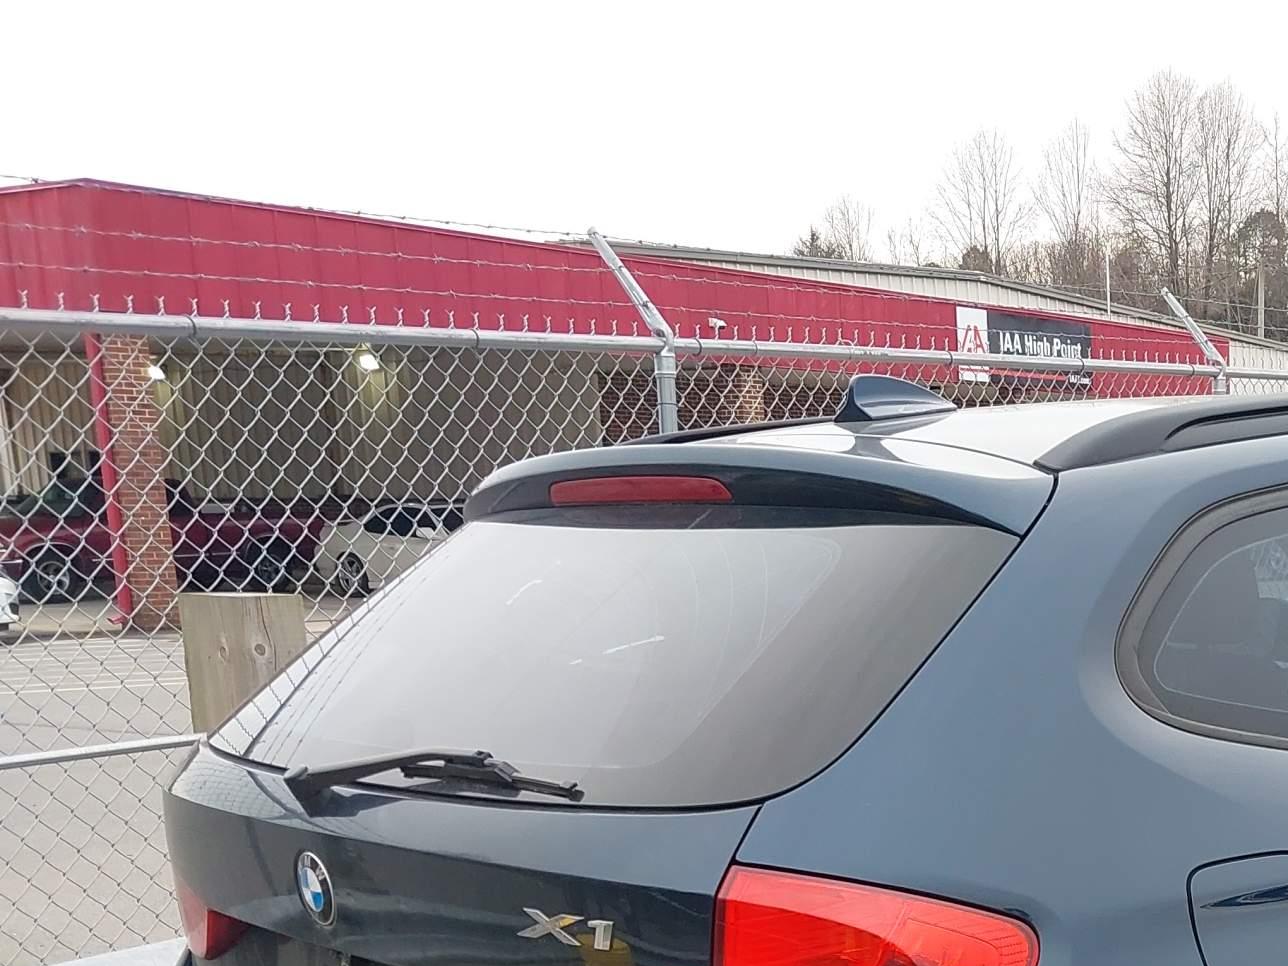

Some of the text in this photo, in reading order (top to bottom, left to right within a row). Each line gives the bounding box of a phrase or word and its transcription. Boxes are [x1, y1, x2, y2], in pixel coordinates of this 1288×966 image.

[999, 330, 1082, 359] IAA High Point
[516, 907, 614, 951] X1
